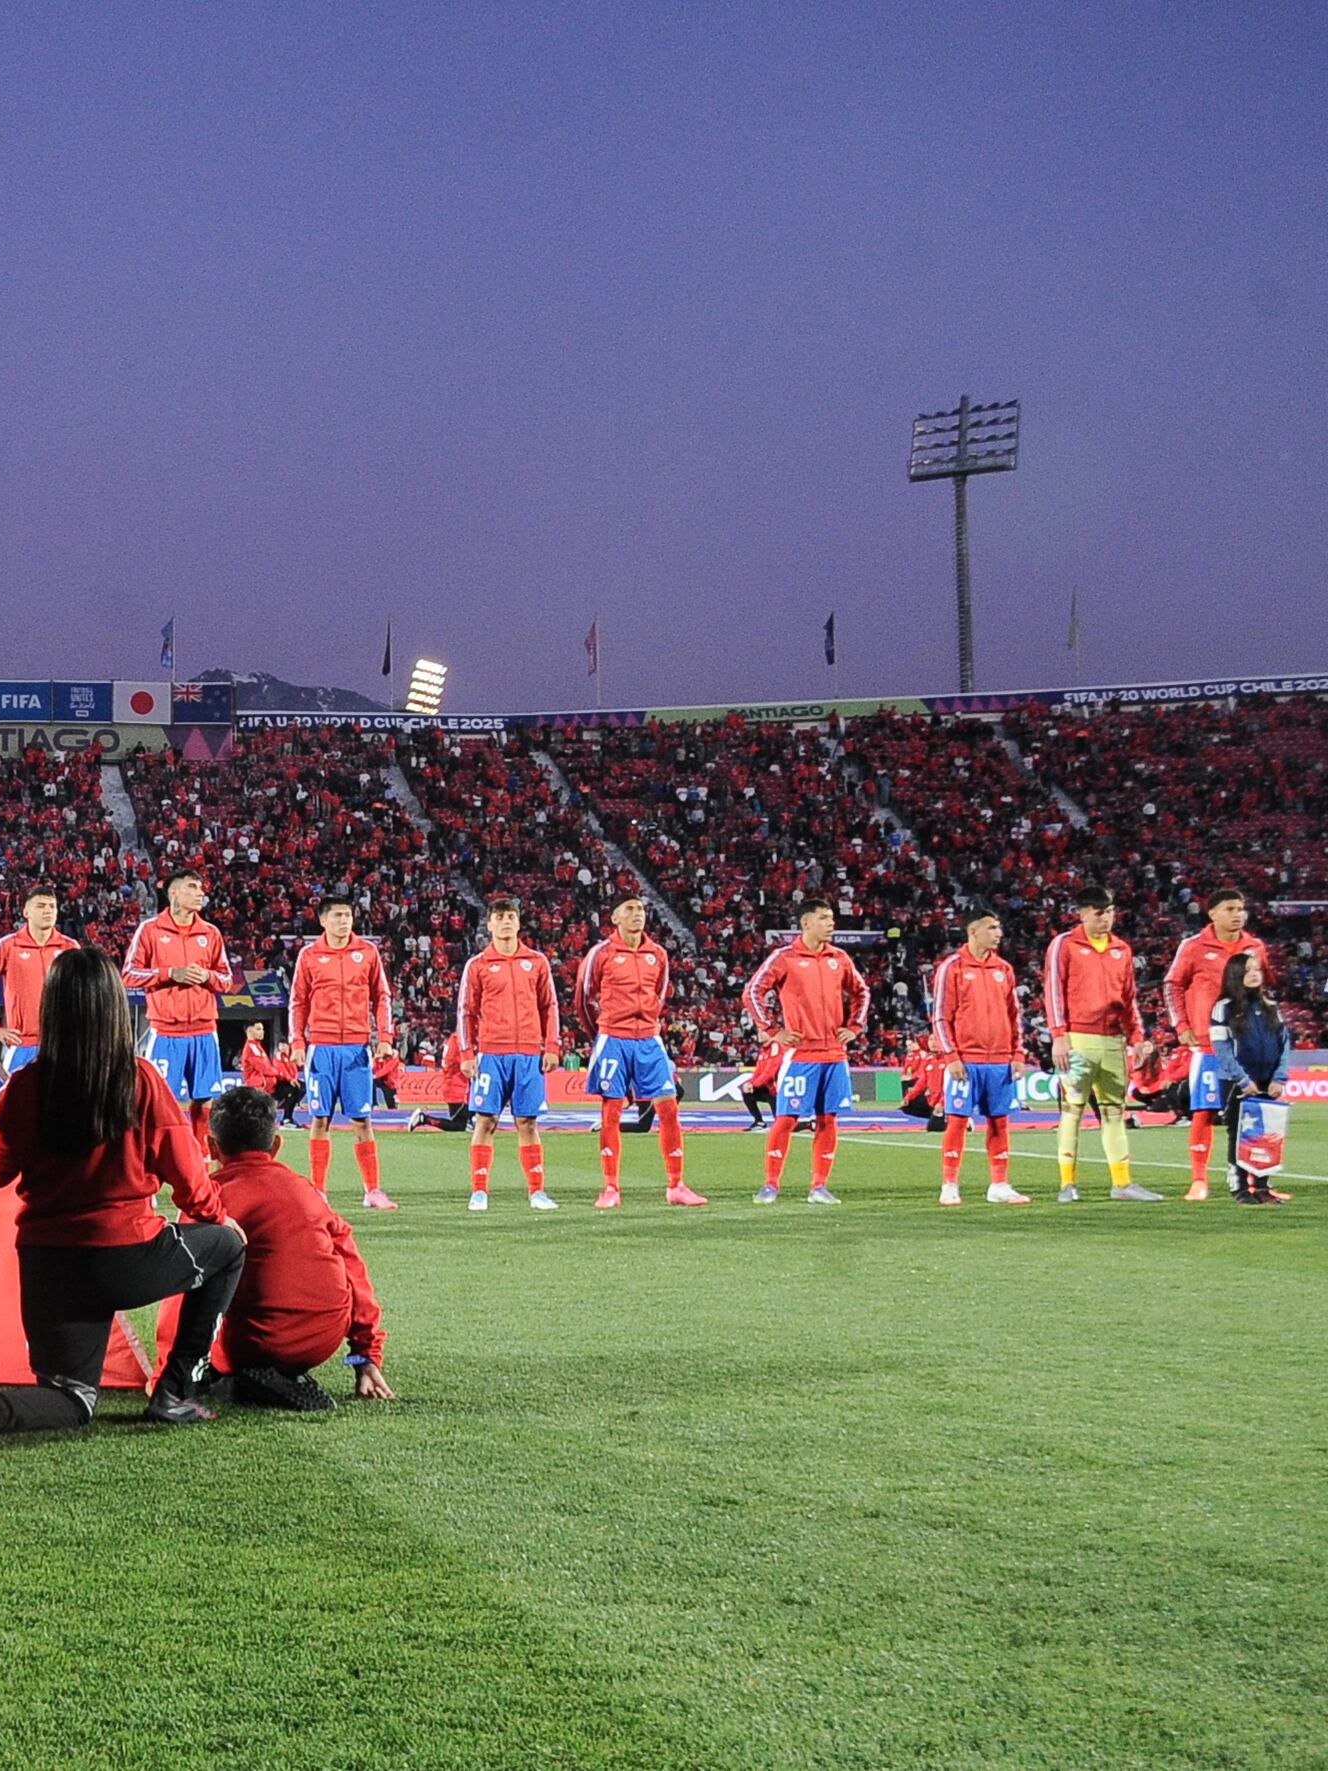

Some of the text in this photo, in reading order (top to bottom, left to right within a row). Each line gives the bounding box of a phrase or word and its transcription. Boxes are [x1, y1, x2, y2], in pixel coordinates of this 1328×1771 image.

[1141, 687, 1200, 700] WORLD
[1203, 683, 1237, 696] CUP
[1239, 680, 1292, 693] CHILE
[1, 694, 42, 709] FIFA
[734, 705, 824, 719] ANTIAGO
[460, 718, 505, 730] 2025
[600, 1058, 619, 1080] 17
[308, 1077, 319, 1097] 4
[473, 1073, 491, 1095] 19
[783, 1076, 807, 1097] 20
[1202, 1071, 1216, 1091] 9
